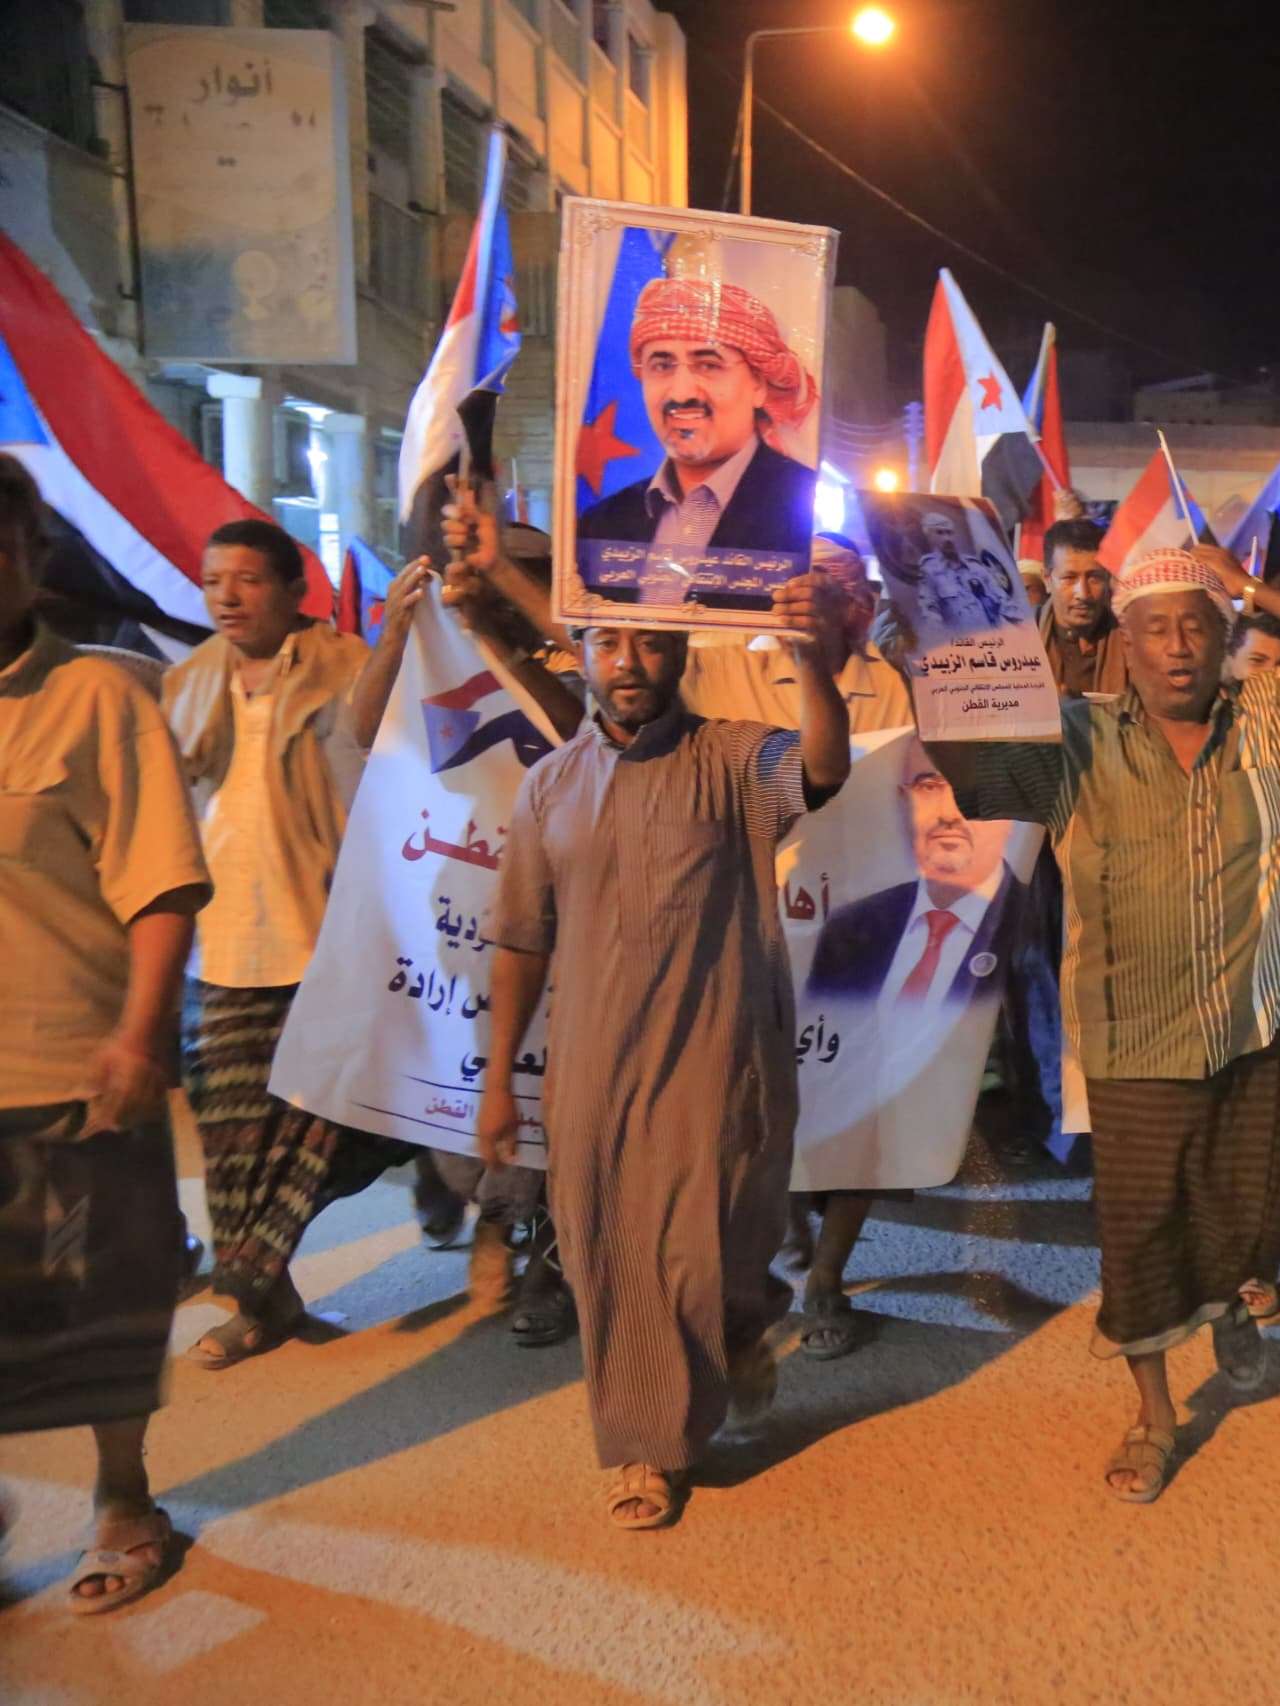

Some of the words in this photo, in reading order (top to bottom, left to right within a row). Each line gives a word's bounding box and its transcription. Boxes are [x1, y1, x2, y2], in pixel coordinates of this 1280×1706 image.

[969, 651, 998, 673] قاسم
[1000, 655, 1041, 672] عيدروس
[961, 698, 990, 713] القطن
[991, 697, 1021, 711] مديرية
[387, 956, 458, 1016] إرادة
[424, 1097, 475, 1119] القطن
